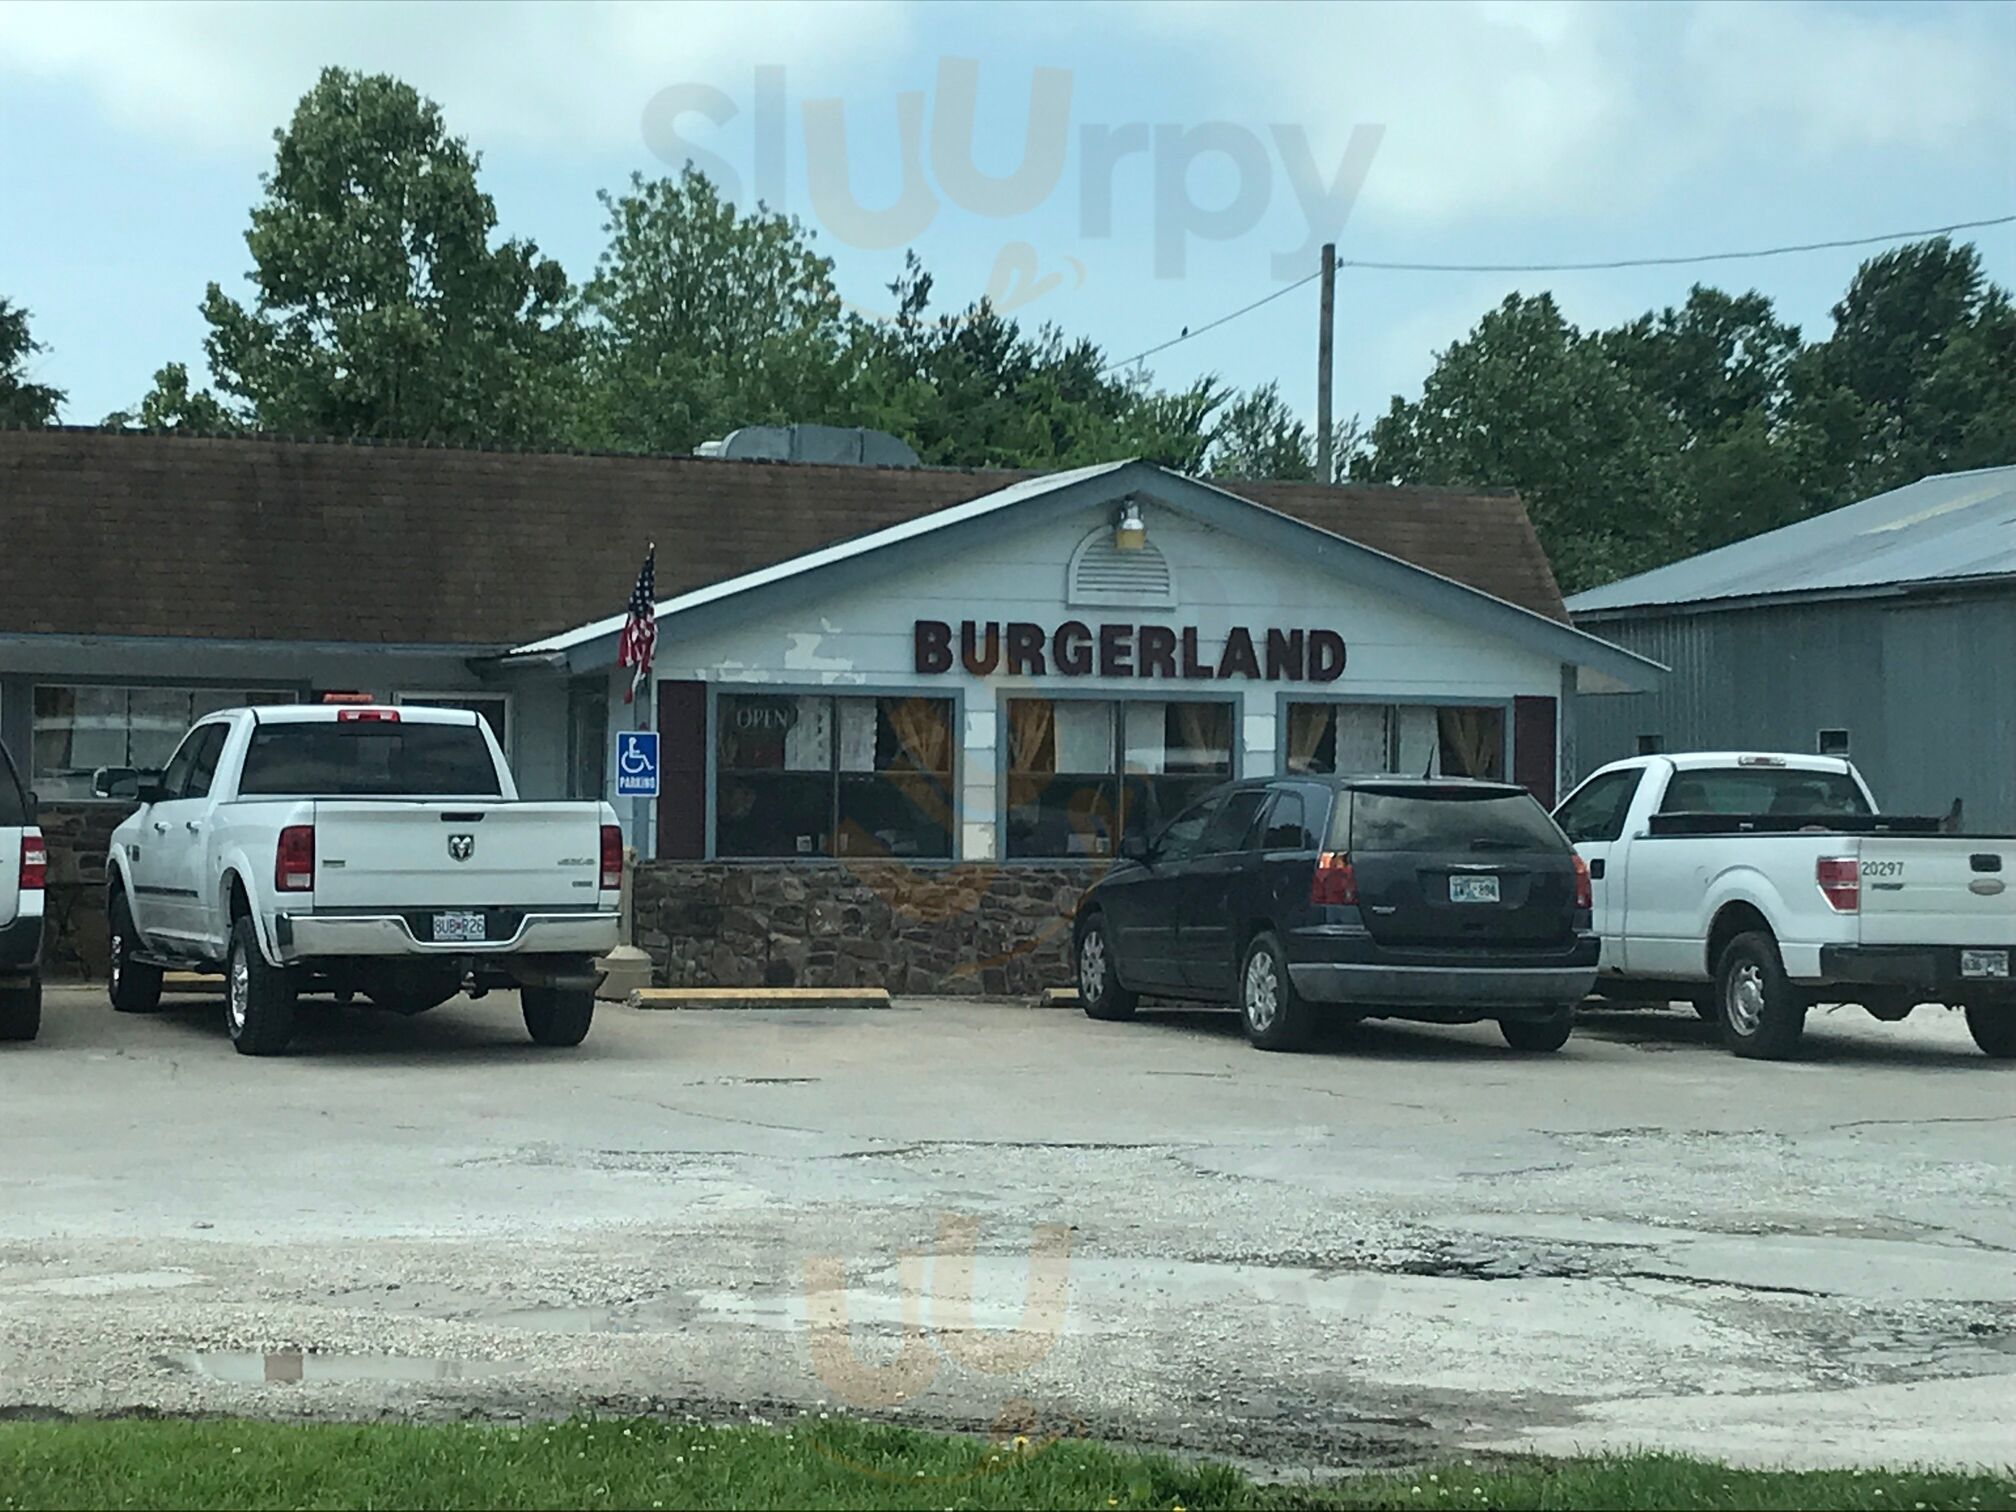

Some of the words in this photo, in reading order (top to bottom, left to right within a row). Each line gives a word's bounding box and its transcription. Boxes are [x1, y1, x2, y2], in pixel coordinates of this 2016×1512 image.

[913, 619, 1347, 683] BURGERLAND
[736, 708, 788, 728] OPEN
[619, 776, 656, 789] PARKING
[1861, 861, 1904, 877] 20297
